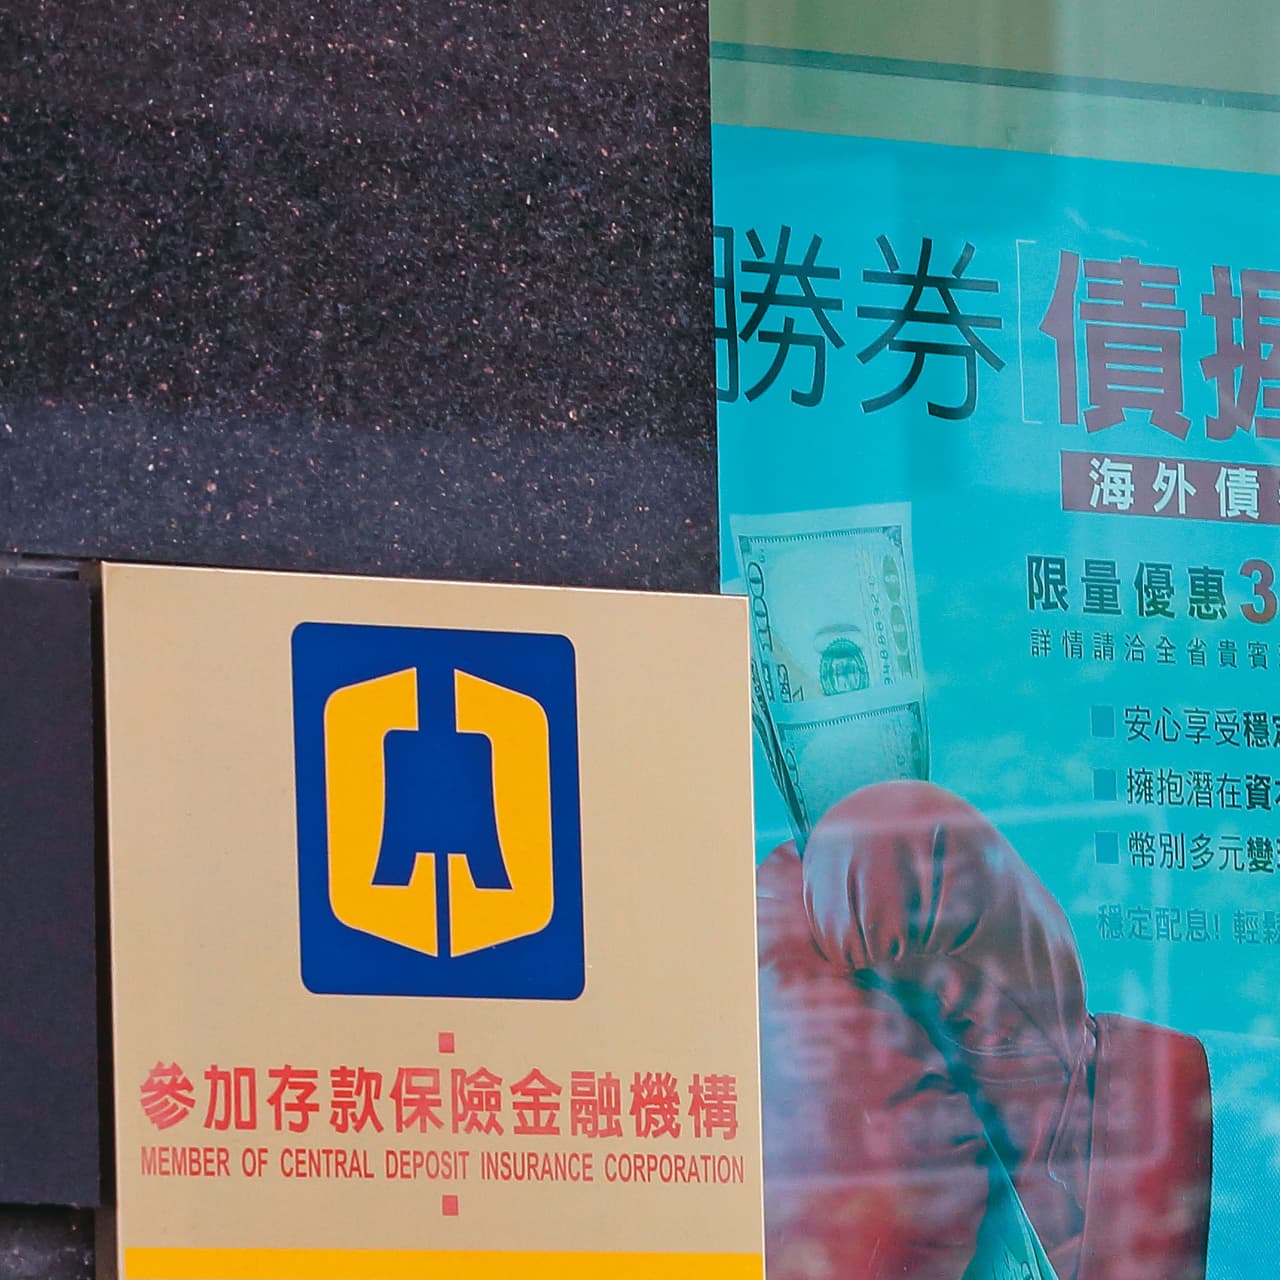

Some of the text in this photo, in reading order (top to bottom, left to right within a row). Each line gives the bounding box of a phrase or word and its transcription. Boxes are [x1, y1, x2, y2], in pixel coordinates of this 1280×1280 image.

[713, 225, 1005, 420] 勝券
[140, 1060, 738, 1141] 參加存款保險金融機構
[140, 1146, 745, 1184] MEMBER OF CENTRAL DEPOSIT INSURANCE CORPORATION
